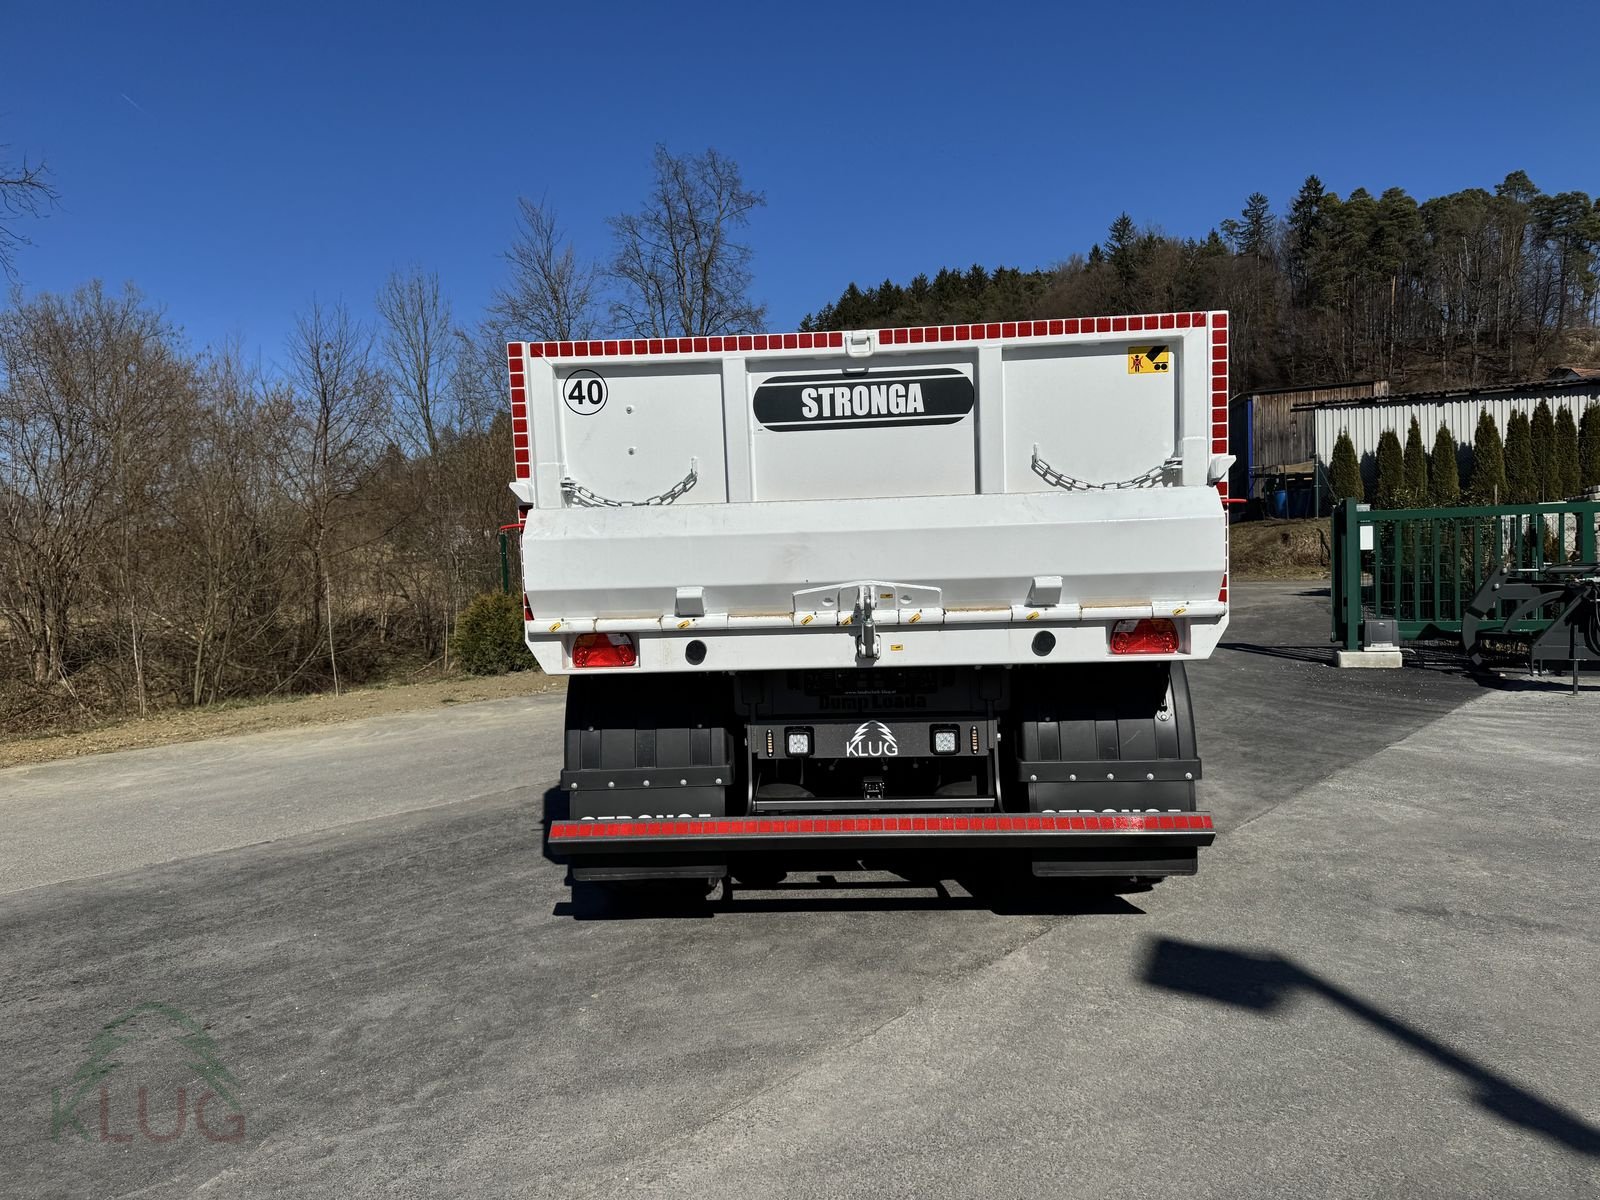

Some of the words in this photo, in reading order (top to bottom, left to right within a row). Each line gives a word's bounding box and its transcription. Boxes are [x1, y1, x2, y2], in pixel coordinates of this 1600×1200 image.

[568, 379, 603, 405] 40
[801, 383, 925, 418] STRONGA
[819, 695, 868, 712] Dump
[846, 741, 898, 757] KLUG
